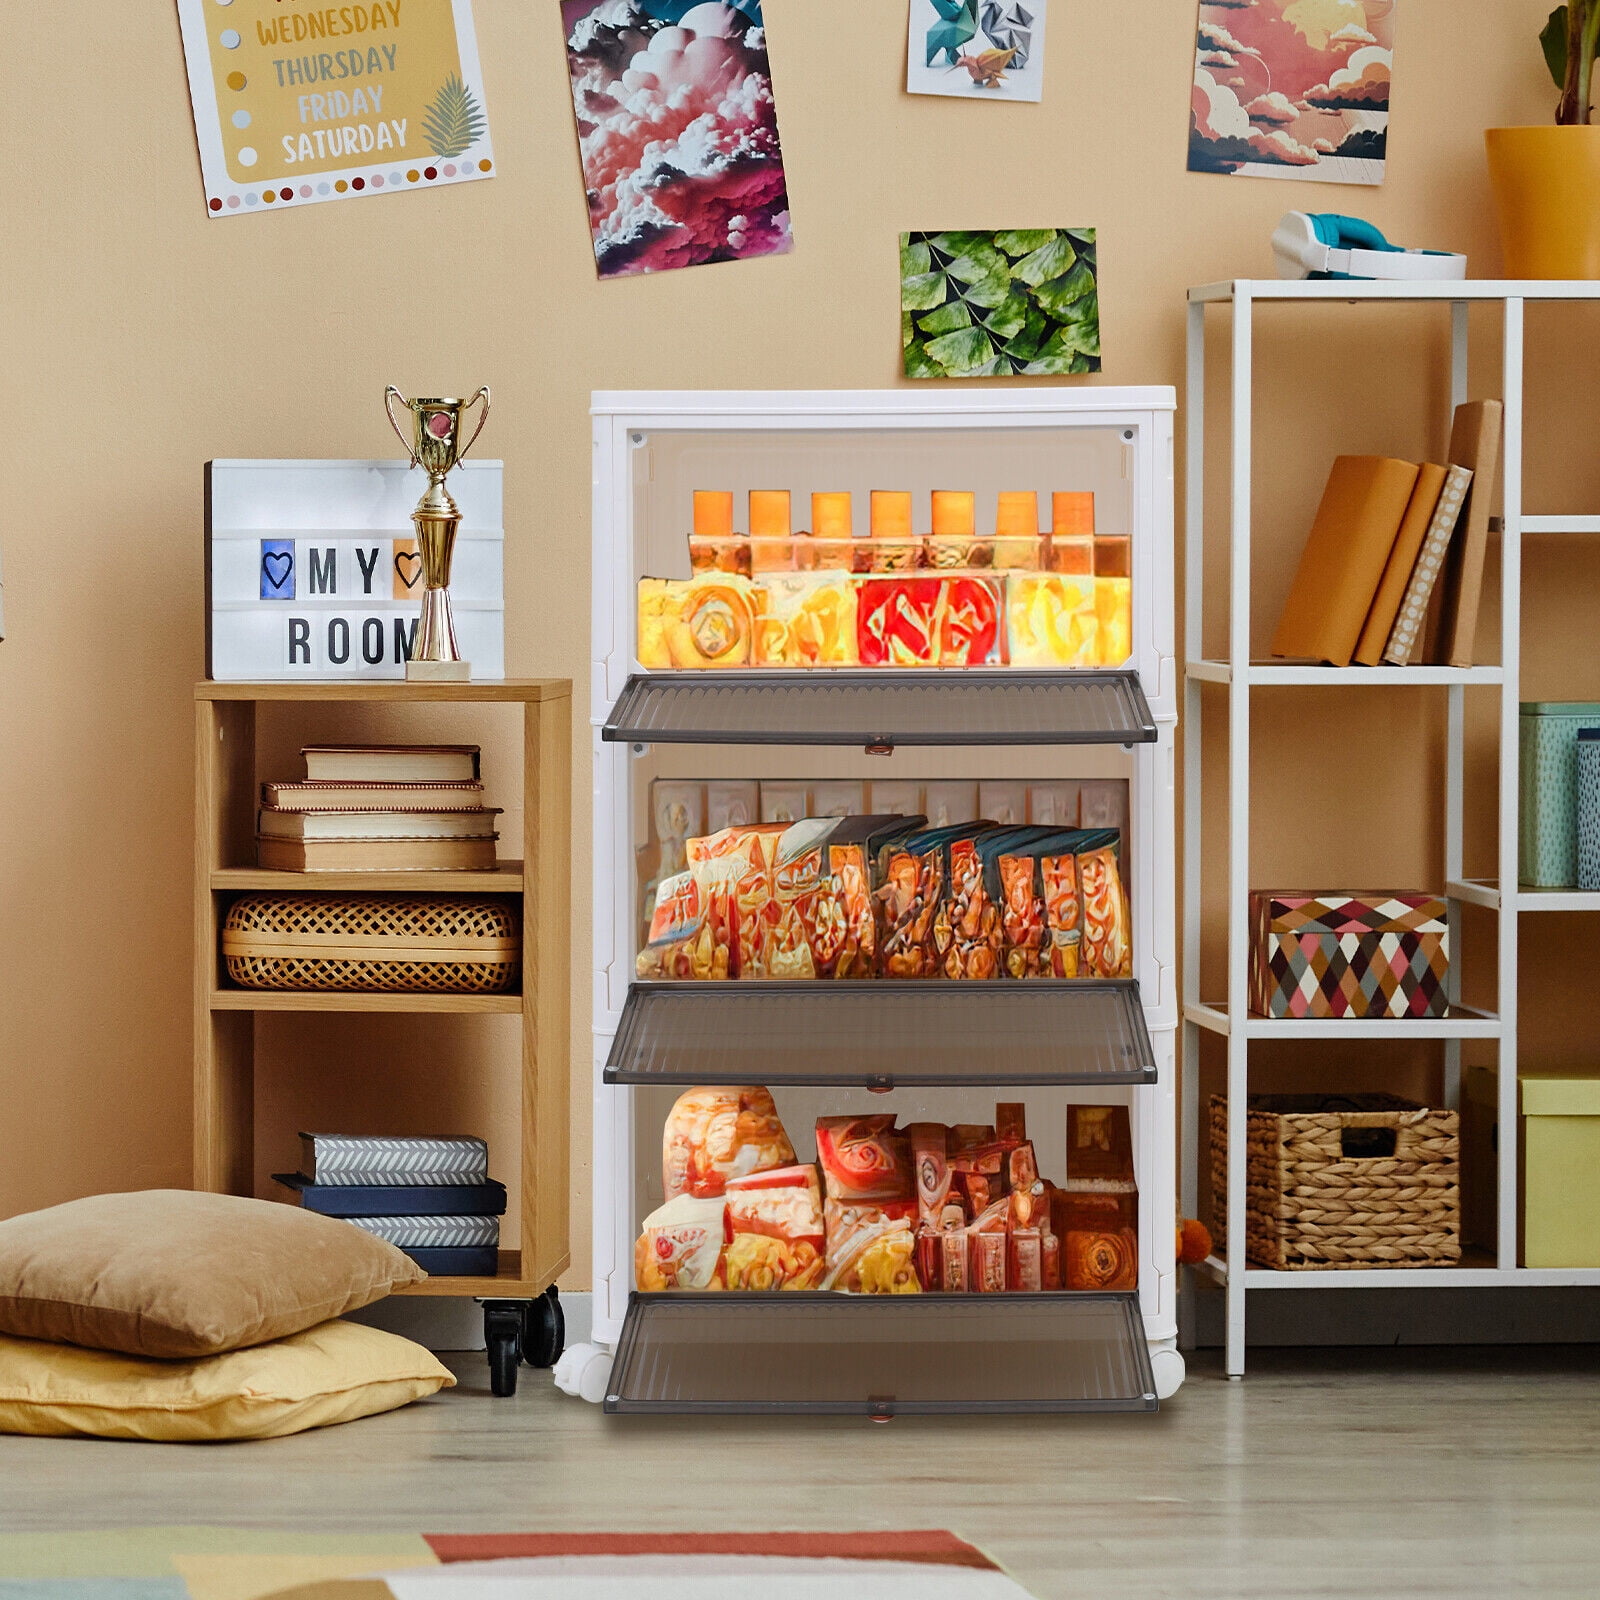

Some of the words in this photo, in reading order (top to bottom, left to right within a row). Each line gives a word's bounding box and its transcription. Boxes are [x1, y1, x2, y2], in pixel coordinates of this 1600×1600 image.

[256, 0, 401, 46] WEDNESDAY
[273, 43, 398, 87] THURSDAY
[281, 118, 407, 164] SATURDAY
[309, 547, 380, 594] MY
